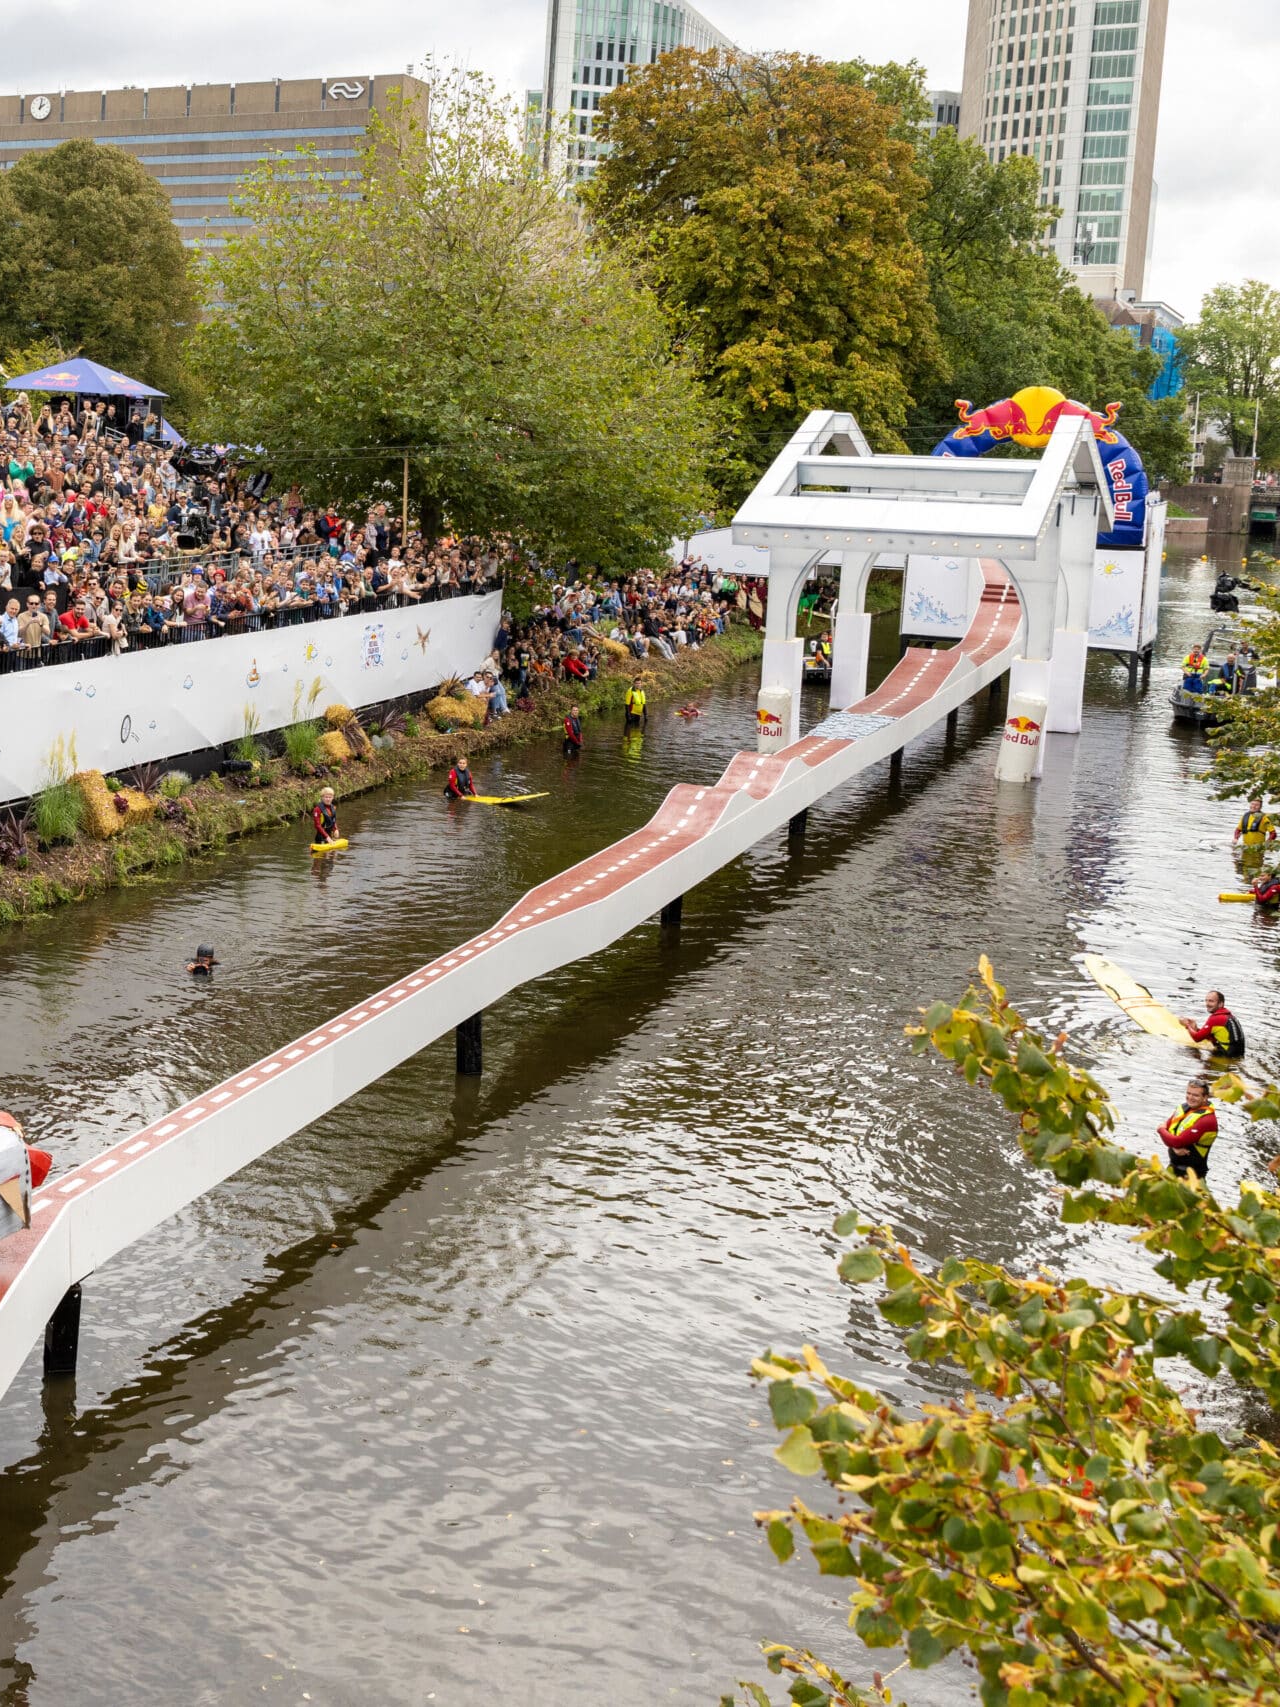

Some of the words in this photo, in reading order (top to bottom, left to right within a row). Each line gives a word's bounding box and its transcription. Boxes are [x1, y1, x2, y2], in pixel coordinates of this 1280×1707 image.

[1107, 459, 1132, 490] Red
[1114, 492, 1132, 521] Bull
[762, 726, 782, 737] Bull
